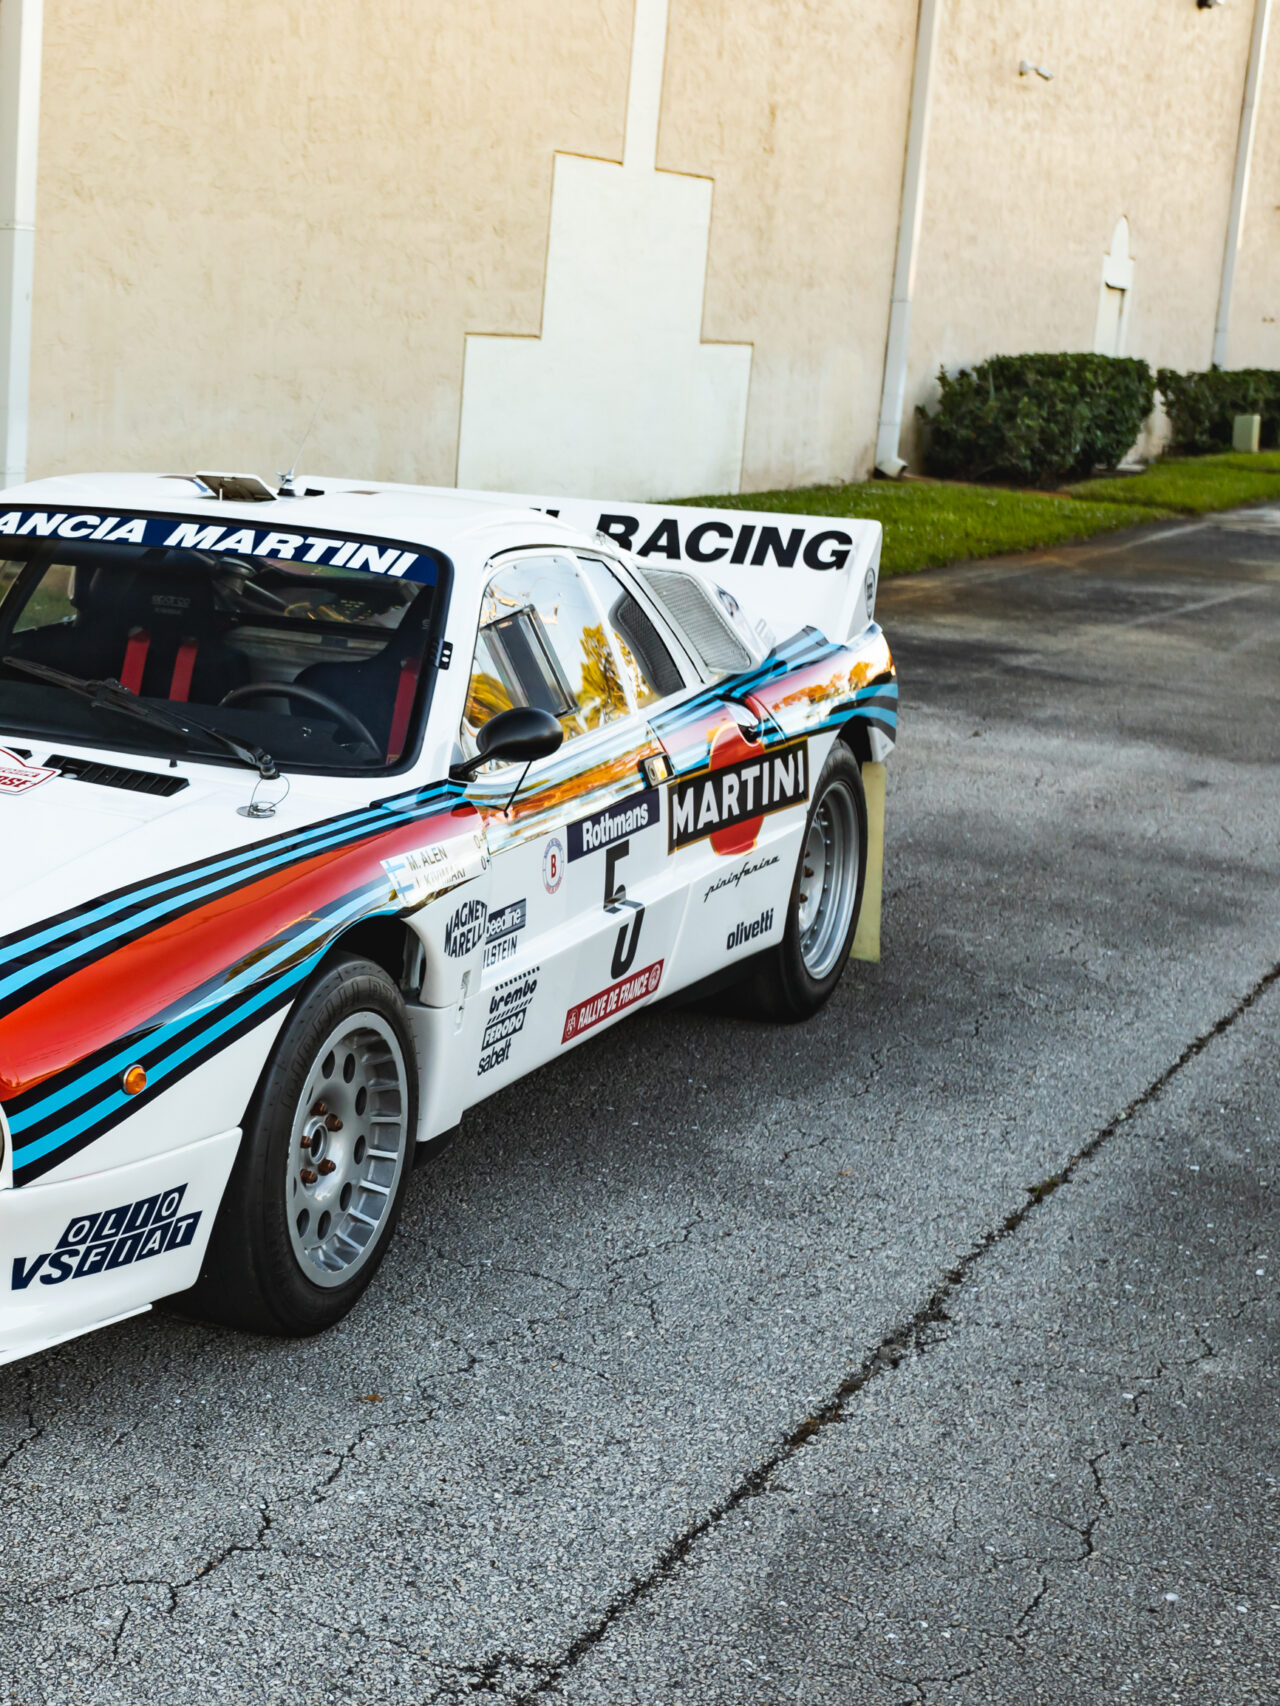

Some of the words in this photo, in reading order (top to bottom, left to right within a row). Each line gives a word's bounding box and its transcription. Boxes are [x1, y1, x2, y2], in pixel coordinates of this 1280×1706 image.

[163, 522, 419, 577] MARTINI
[595, 513, 854, 571] RACING
[672, 749, 805, 841] MARTINI
[582, 803, 649, 852] Rothmans
[551, 853, 557, 879] B
[726, 908, 774, 951] olivetti
[489, 979, 538, 1015] brembo
[578, 994, 608, 1030] RALLYE
[606, 987, 620, 1014] DE
[618, 972, 650, 1008] FRANCE
[483, 1010, 524, 1048] FERODO
[477, 1037, 512, 1076] sabelt
[67, 1191, 180, 1243] OLIO
